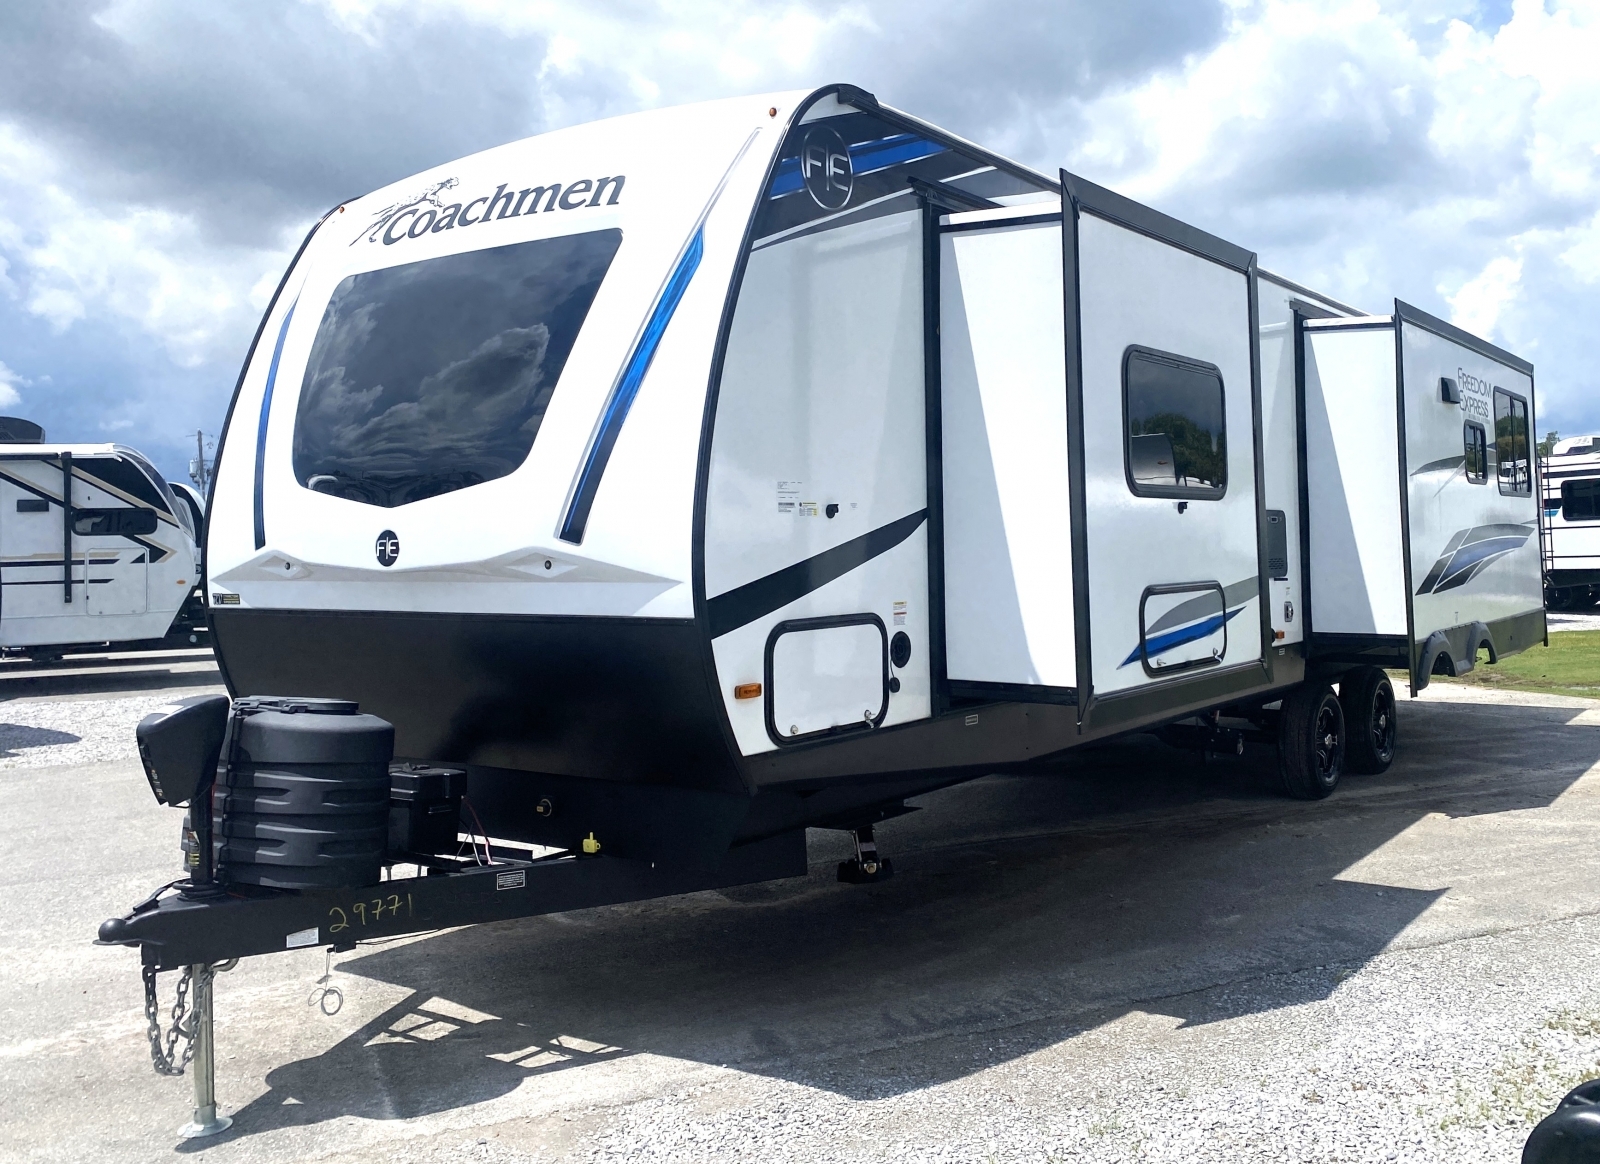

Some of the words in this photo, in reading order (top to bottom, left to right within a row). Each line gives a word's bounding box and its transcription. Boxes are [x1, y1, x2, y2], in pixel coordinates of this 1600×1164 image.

[382, 175, 626, 246] Coachmen
[1458, 367, 1492, 399] FREEDOM
[1459, 390, 1489, 418] EXPRESS
[329, 893, 414, 933] 29771
